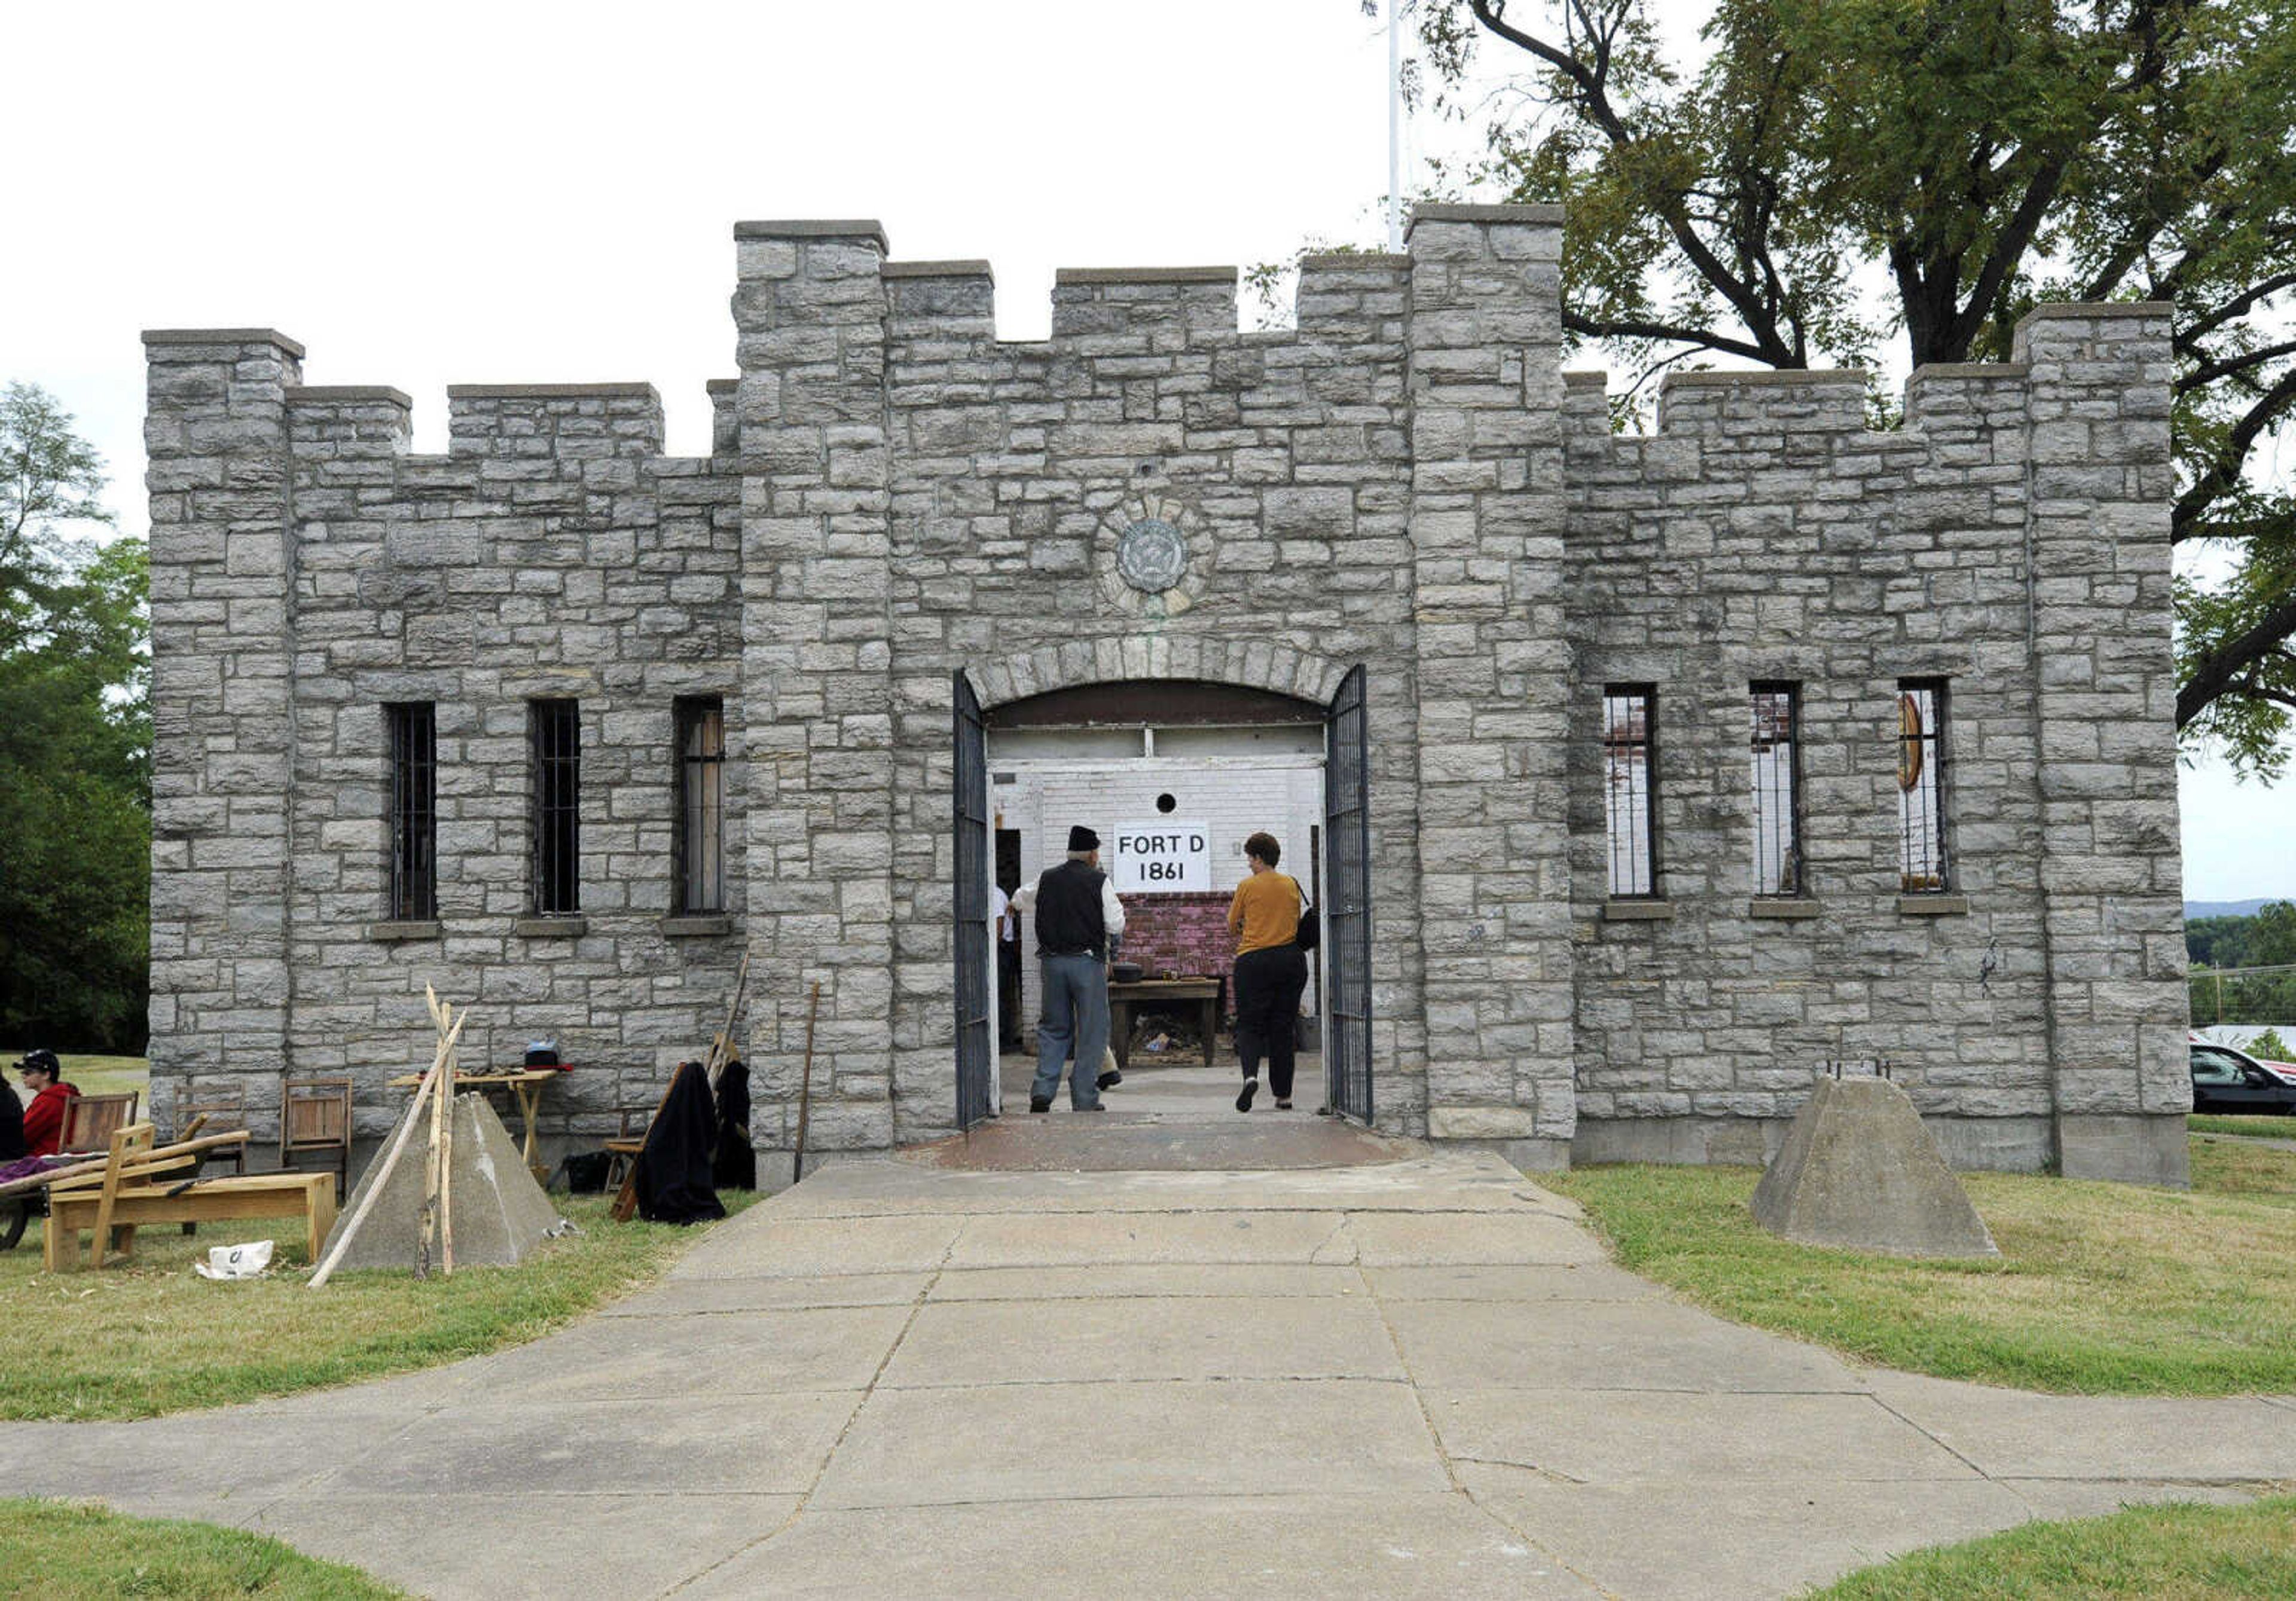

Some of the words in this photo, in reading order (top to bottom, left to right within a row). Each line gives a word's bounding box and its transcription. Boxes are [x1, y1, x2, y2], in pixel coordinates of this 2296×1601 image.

[1119, 835, 1181, 854] FORT
[1190, 835, 1204, 852] D
[1140, 862, 1183, 881] 1861
